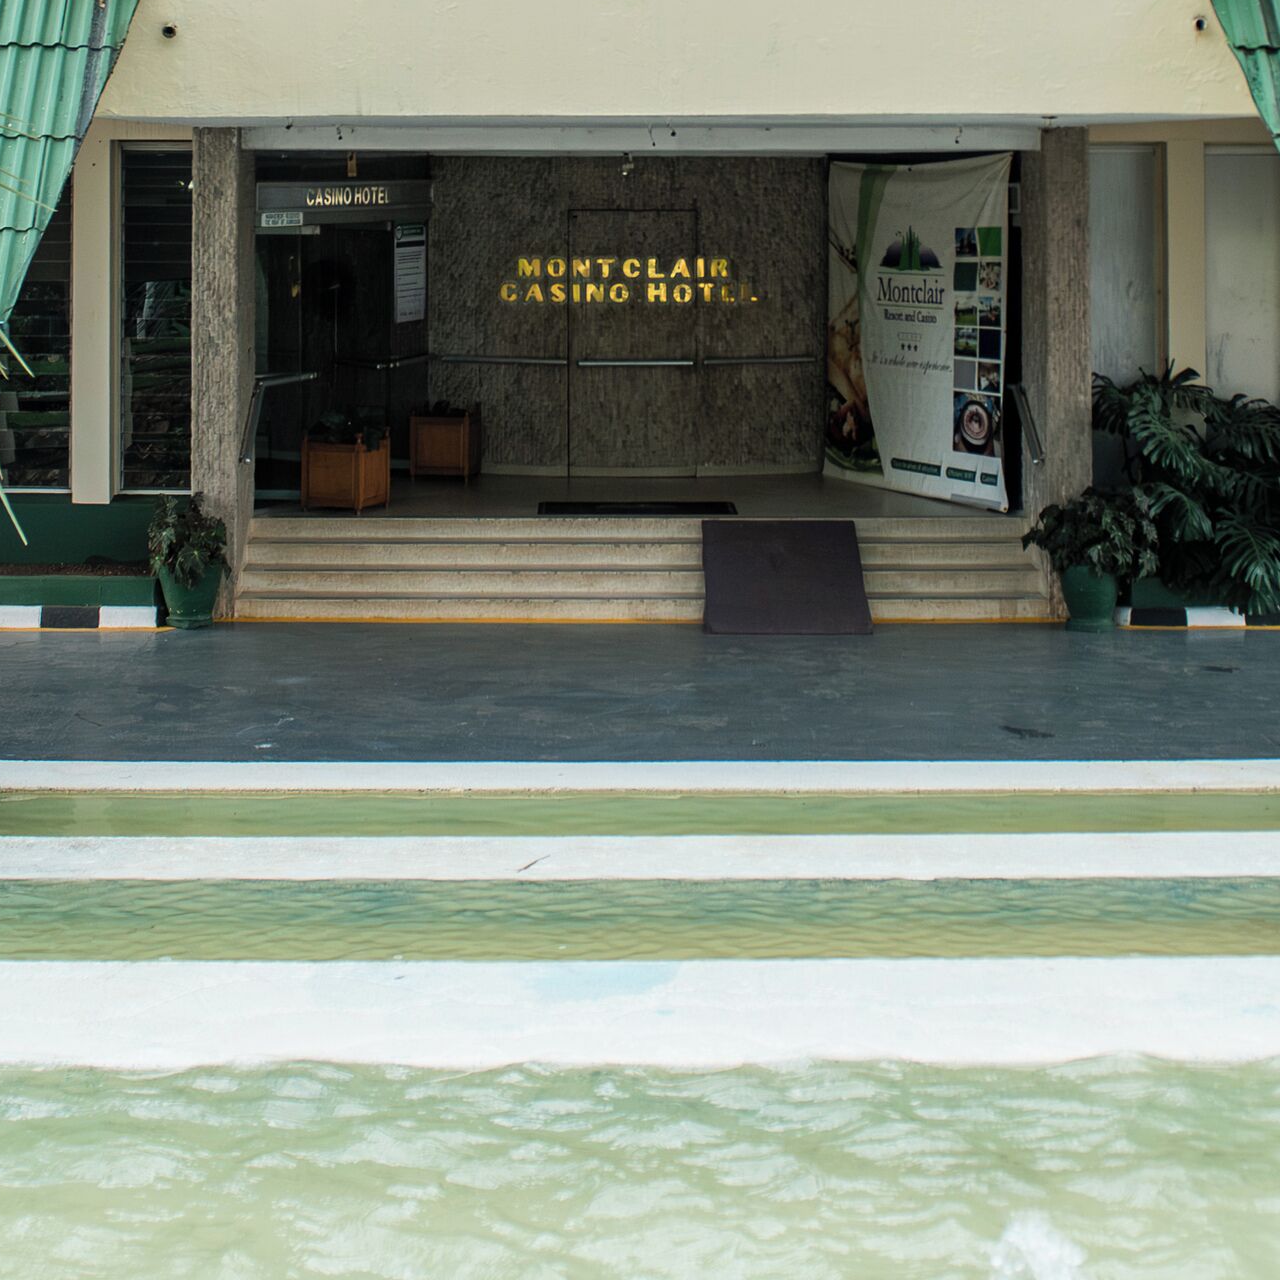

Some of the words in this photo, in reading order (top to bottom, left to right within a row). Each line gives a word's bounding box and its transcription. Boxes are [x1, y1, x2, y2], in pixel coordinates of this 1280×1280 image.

[306, 187, 352, 206] CASINO
[354, 186, 389, 204] HOTEL
[518, 258, 729, 278] MONTCLAIR
[500, 283, 630, 303] CASINO
[877, 277, 945, 305] Montclair
[884, 308, 904, 321] Resort
[905, 309, 916, 322] and
[916, 310, 938, 324] Casino
